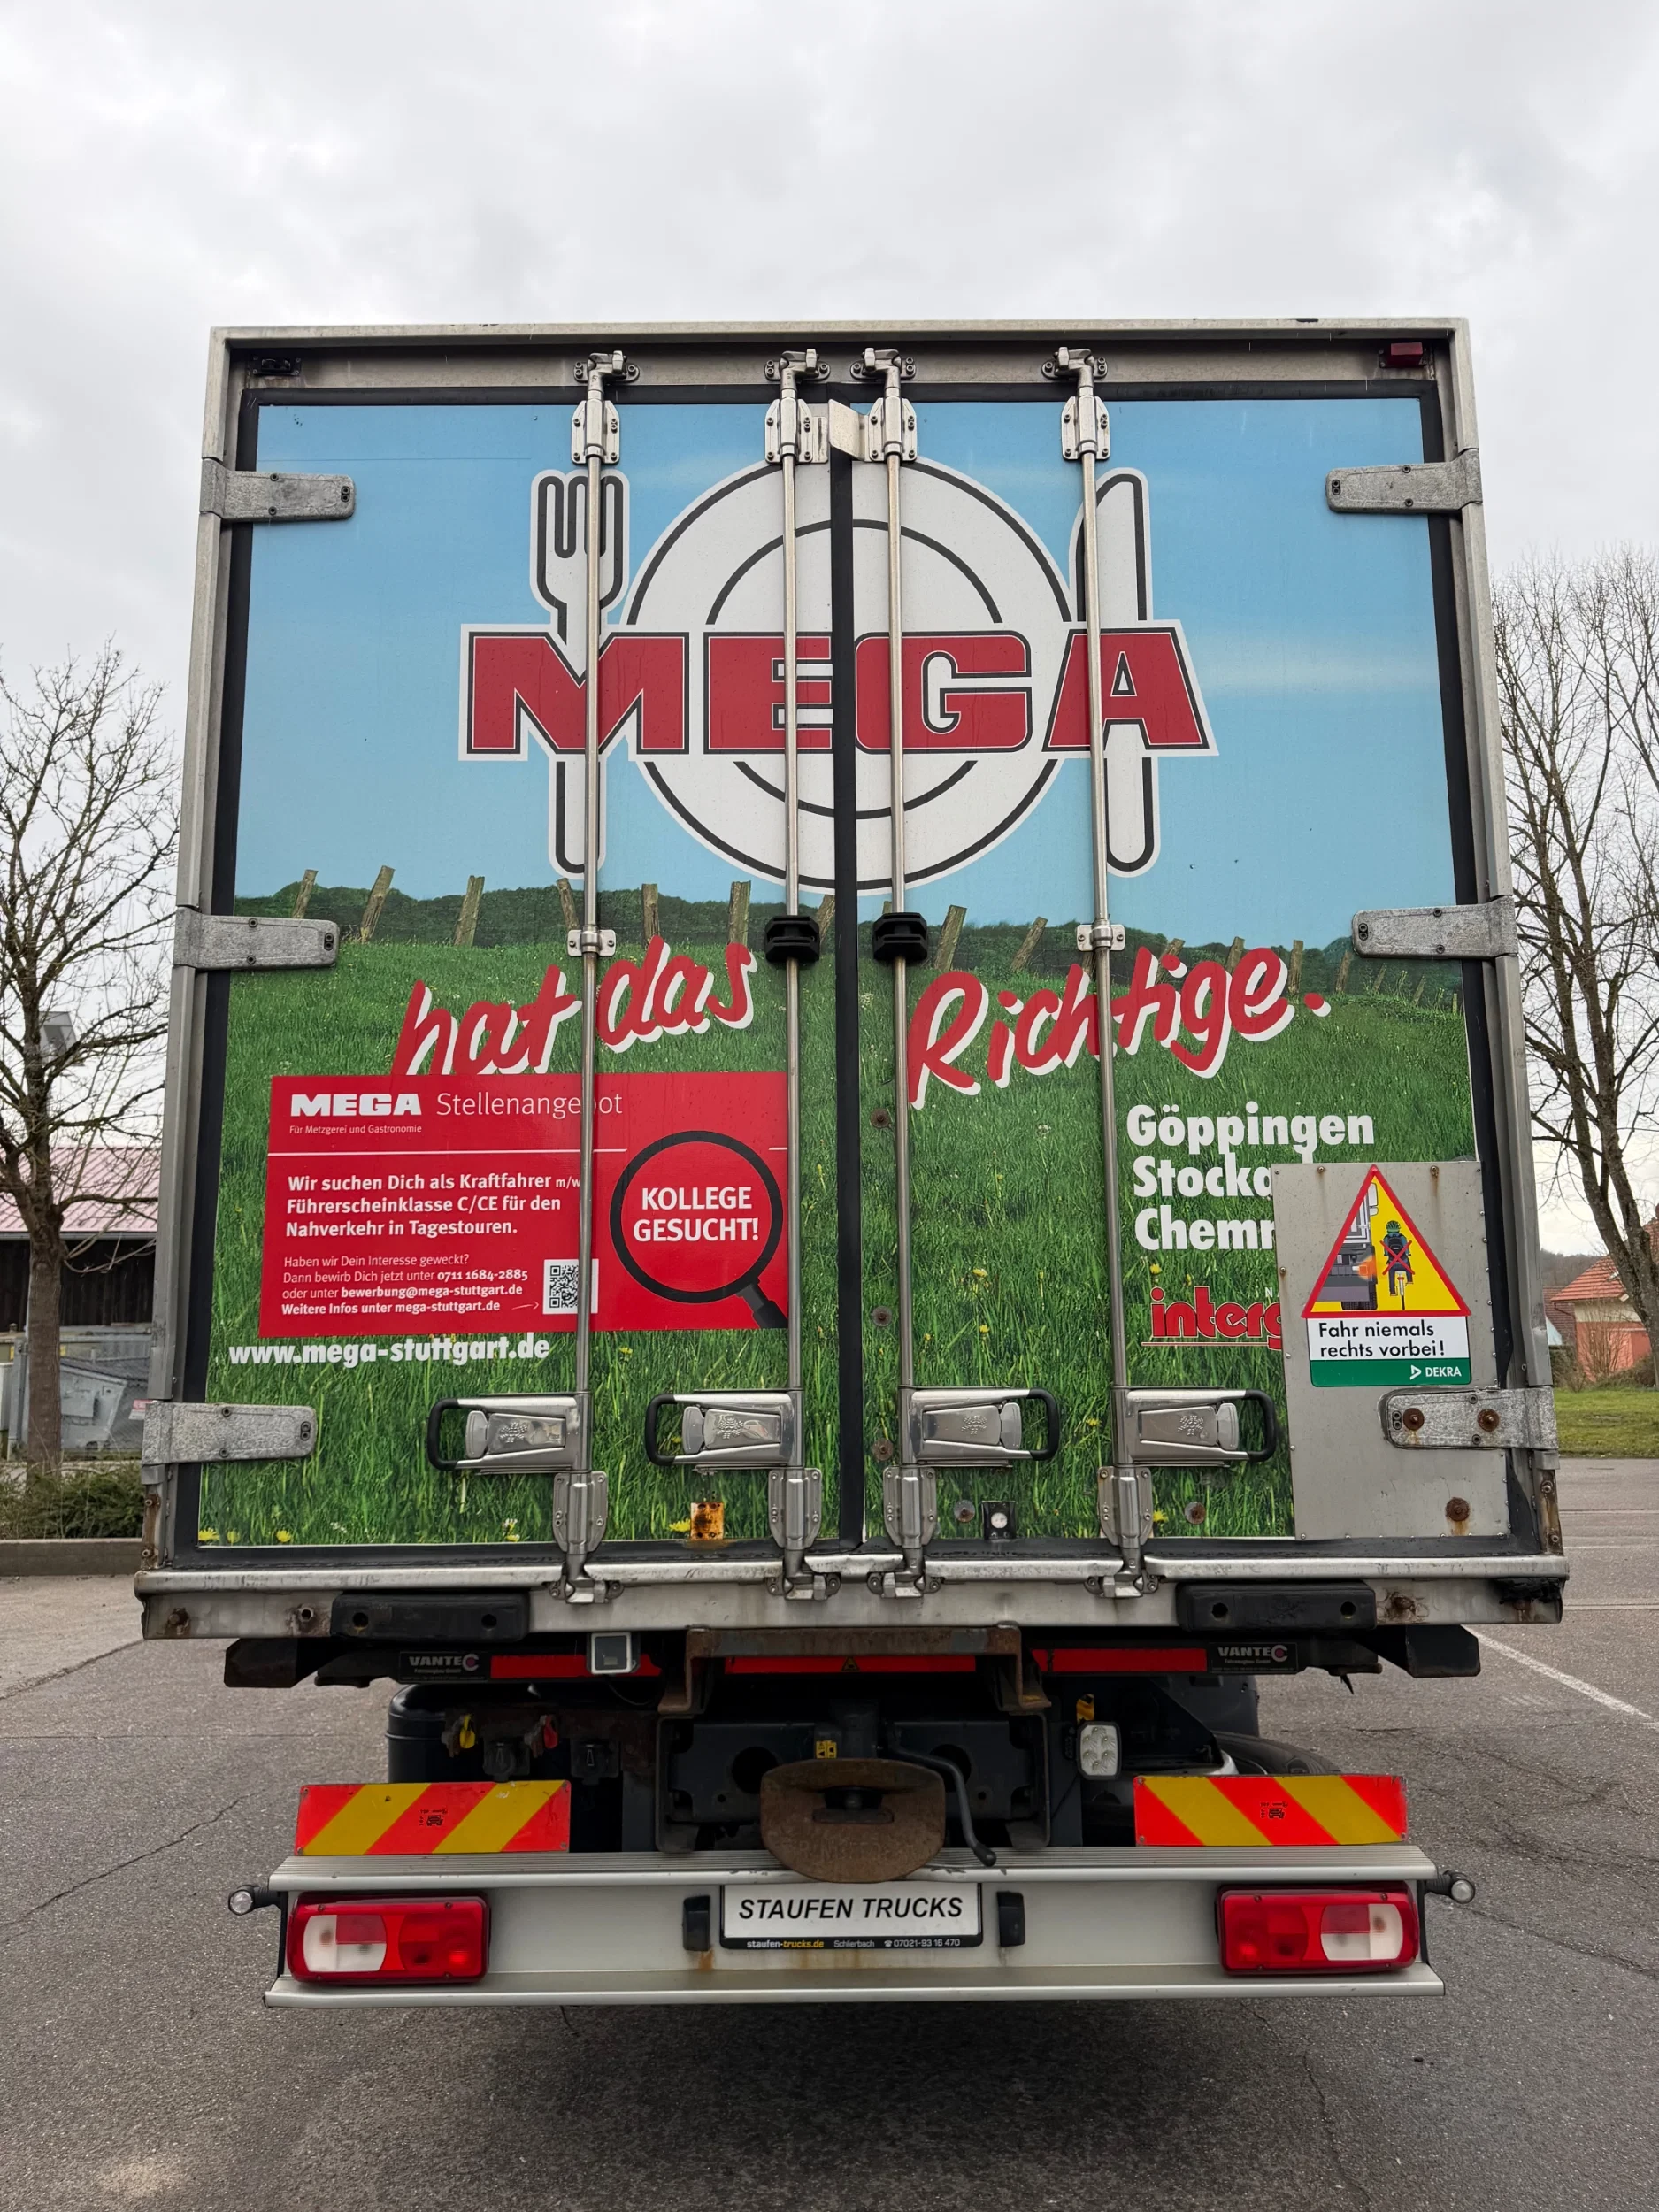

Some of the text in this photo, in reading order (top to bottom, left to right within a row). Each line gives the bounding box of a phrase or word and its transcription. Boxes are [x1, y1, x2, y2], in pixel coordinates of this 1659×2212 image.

[465, 627, 1212, 756] MEGA
[391, 935, 1331, 1110] hat das Richtige.
[290, 1091, 623, 1119] MEGA Stellenangeot
[289, 1125, 303, 1134] Für
[305, 1125, 347, 1135] Metzgerei
[367, 1124, 422, 1133] Gastronomie
[1126, 1101, 1375, 1164] Göppingen
[288, 1176, 318, 1191] Wir
[321, 1175, 382, 1191] suchen
[388, 1174, 425, 1190] Dich
[429, 1174, 455, 1189] als
[459, 1172, 551, 1189] Kraftfahrer
[287, 1195, 561, 1215] Führerscheinklasse C/CE für den
[641, 1187, 752, 1210] KOLLEGE
[286, 1220, 518, 1239] Nahverkehr in Tagestouren.
[633, 1217, 759, 1242] GESUCHT!
[284, 1254, 469, 1268] Haben wir Dein Interesse geweckt?
[283, 1269, 528, 1284] Dann bewirb Dich jetzt unter 0711 1684-2885
[282, 1284, 523, 1300] oder unter bewerbung@mega-stuttgart.de
[281, 1300, 501, 1315] Weitere Infos unter mega-stuttgart.de
[1318, 1319, 1434, 1337] Fahr niemals
[228, 1332, 550, 1369] www.mega-stuttgart.de
[1320, 1340, 1445, 1357] rechts vorbei!
[1425, 1366, 1462, 1378] DEKRA
[409, 1653, 479, 1671] VANTEC
[1217, 1644, 1288, 1663] VANTEC
[739, 1897, 964, 1919] STAUFEN TRUCKS
[747, 1939, 825, 1948] staufen-trucks.de
[944, 1938, 961, 1947] 470
